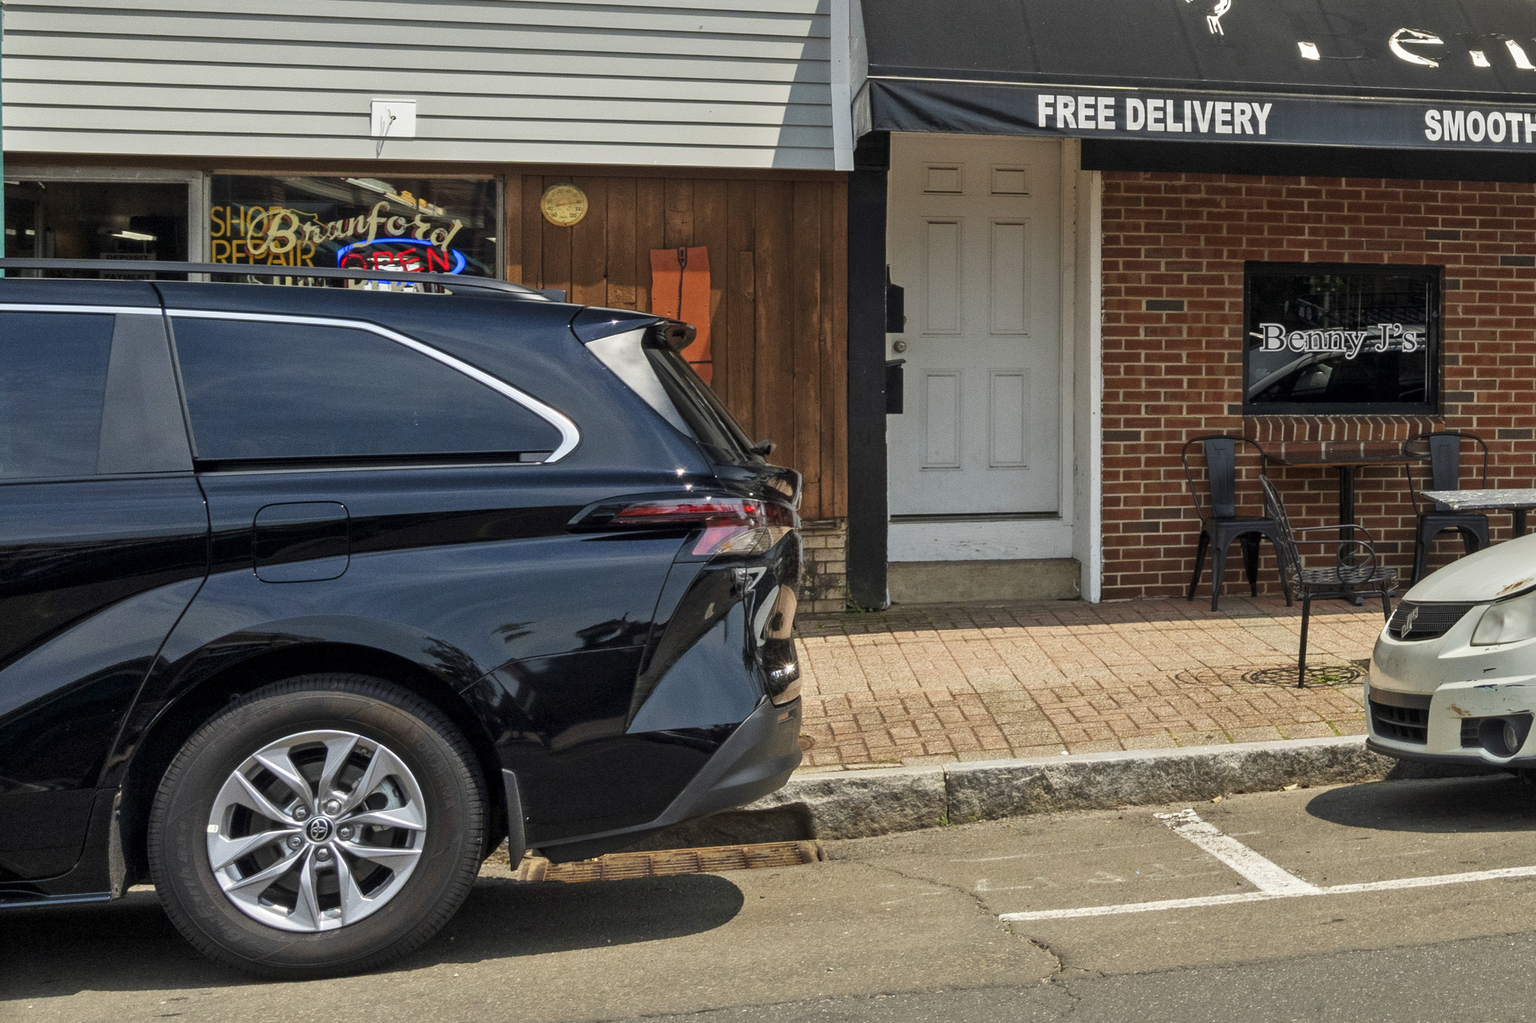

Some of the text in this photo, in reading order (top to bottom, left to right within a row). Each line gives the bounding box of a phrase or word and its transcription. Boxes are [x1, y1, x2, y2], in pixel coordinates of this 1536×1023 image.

[1037, 94, 1273, 135] FREE DELIVERY
[245, 200, 464, 256] Branford
[211, 239, 315, 268] REPAIR
[340, 247, 451, 273] OPEN
[1259, 322, 1419, 360] Benny J's
